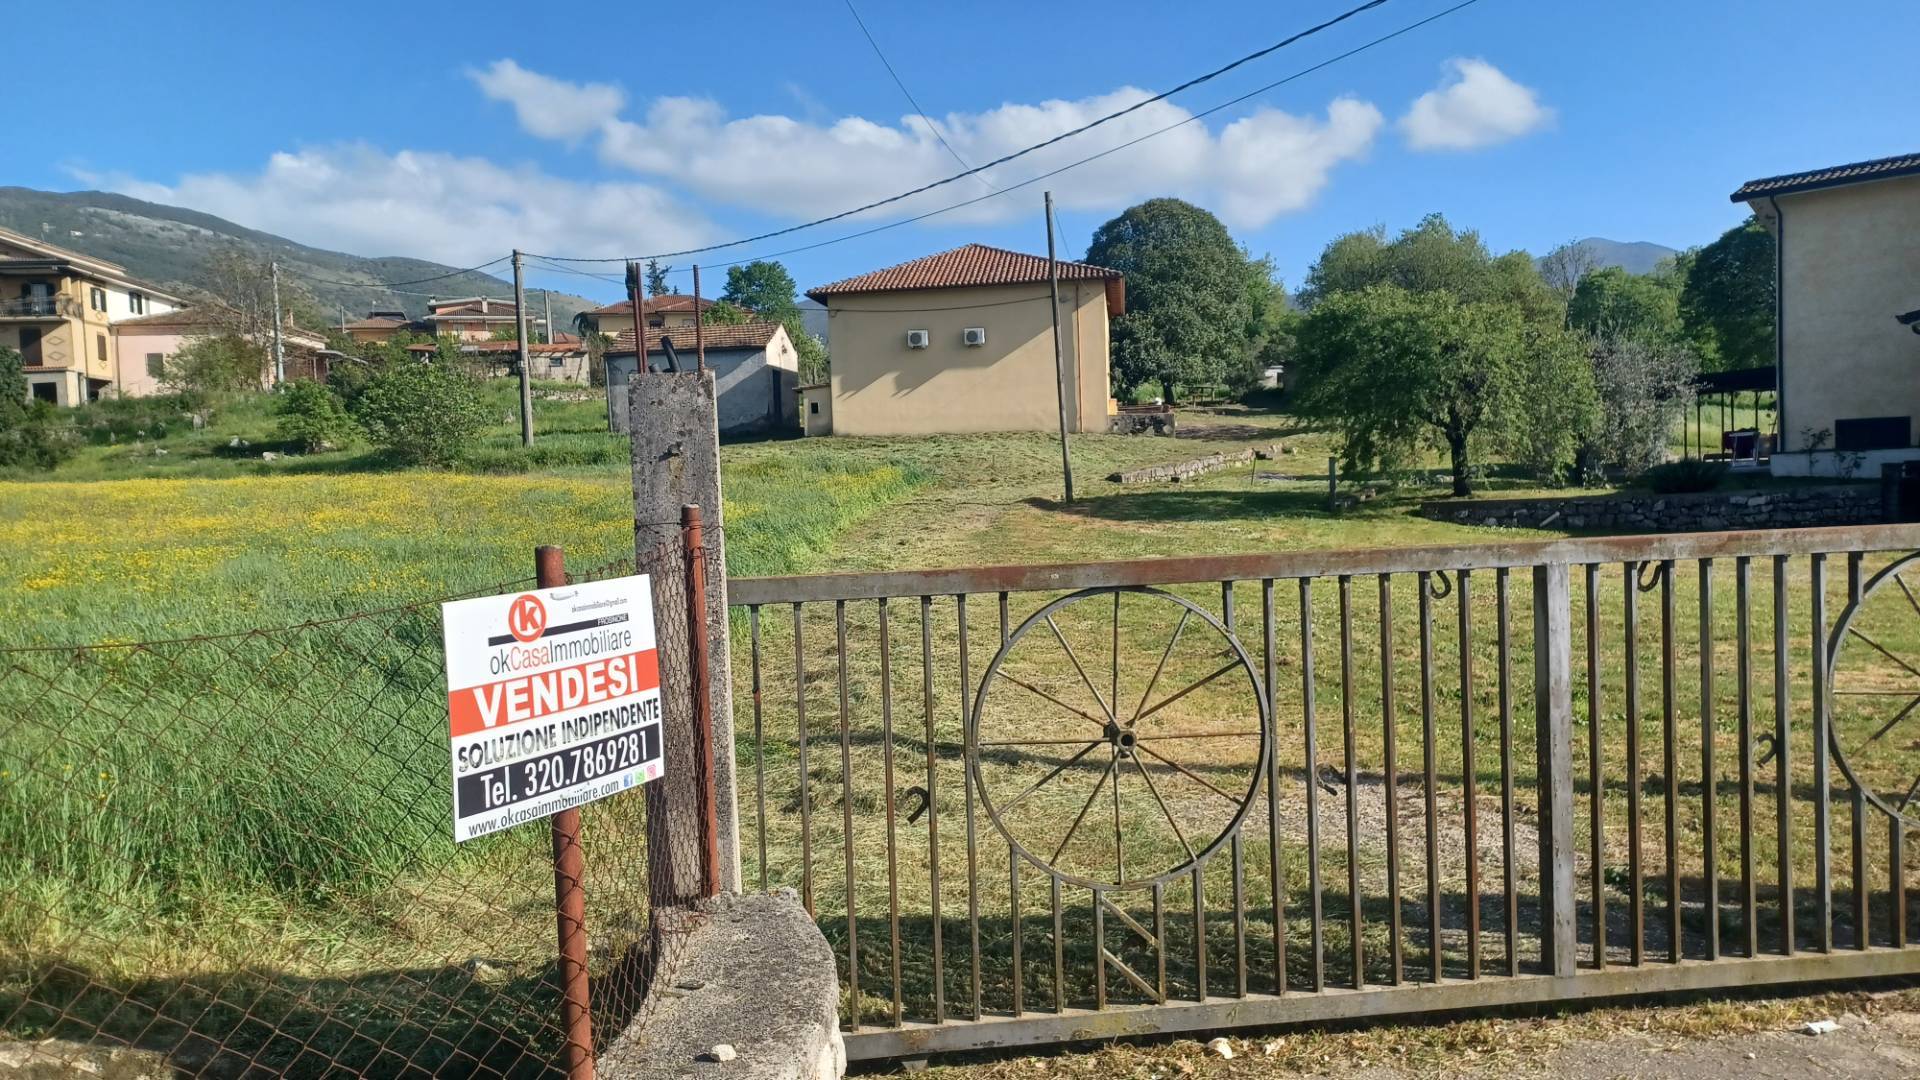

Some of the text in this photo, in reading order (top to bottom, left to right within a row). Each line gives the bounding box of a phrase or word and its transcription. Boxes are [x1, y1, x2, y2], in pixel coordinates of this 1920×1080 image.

[490, 629, 632, 675] okCasaImmobiliare
[472, 655, 638, 728] VENDESI
[458, 697, 659, 773] SOLUZIONE INDIPENDENTE
[480, 730, 648, 809] Tel. 320.7869281
